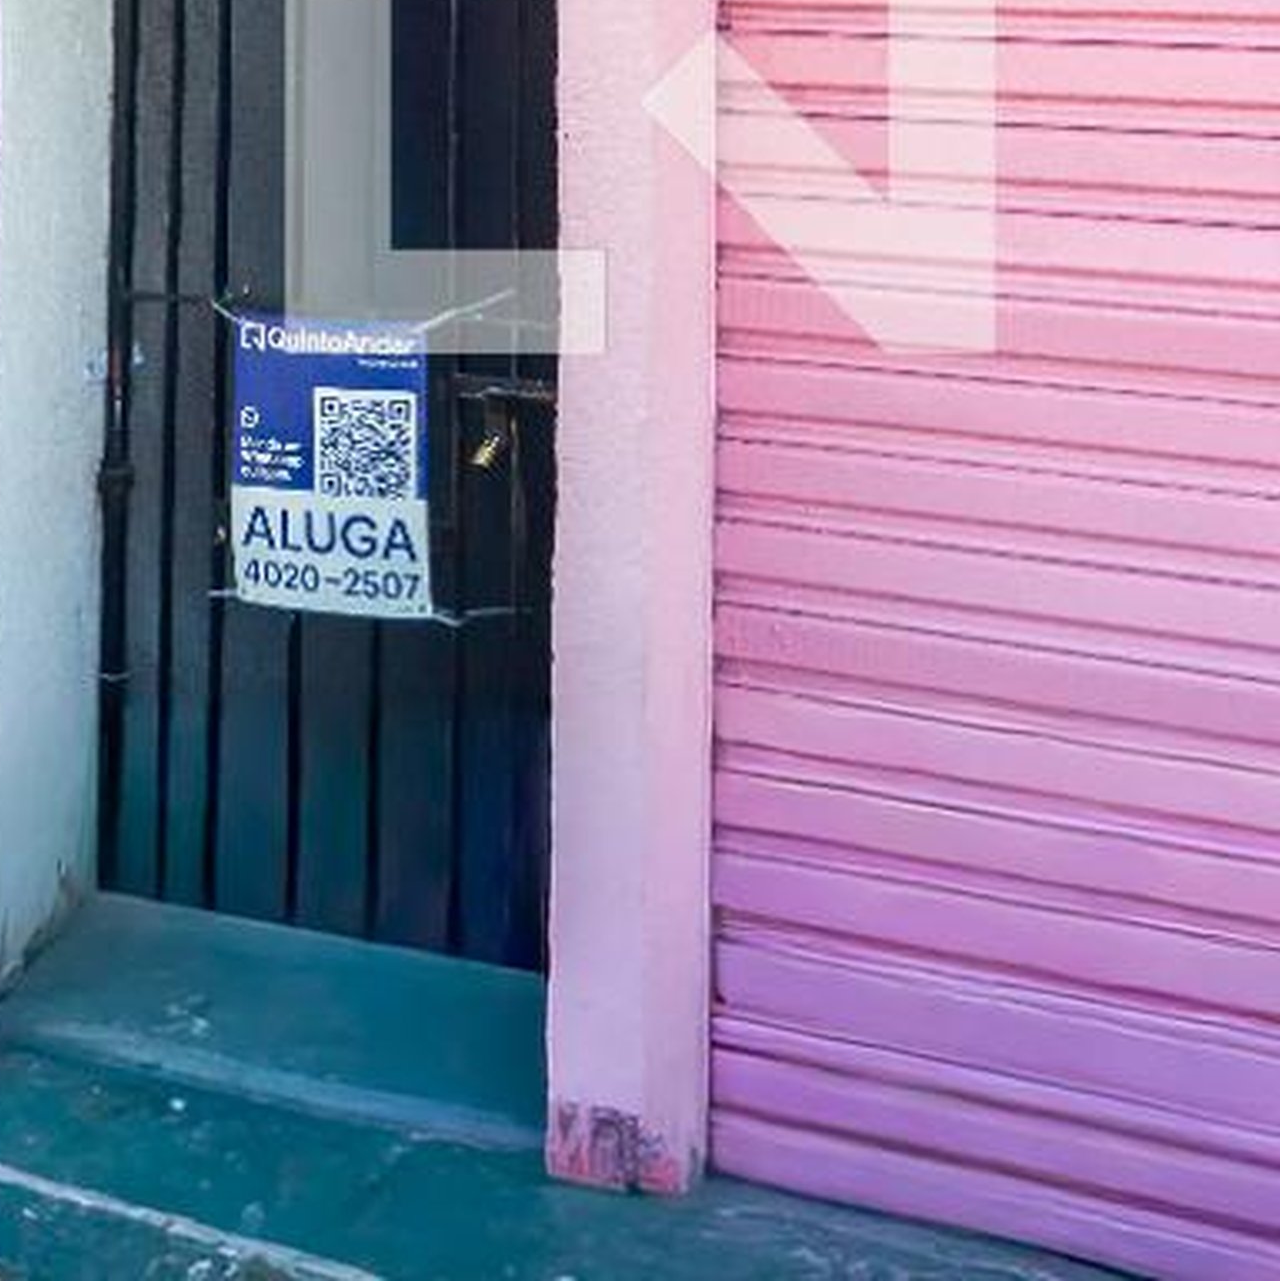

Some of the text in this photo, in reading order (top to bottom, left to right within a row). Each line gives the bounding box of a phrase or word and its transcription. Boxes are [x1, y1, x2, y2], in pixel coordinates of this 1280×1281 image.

[268, 325, 418, 355] QuintoAndar
[242, 506, 416, 562] ALUGA
[244, 559, 420, 600] 4020-2507
